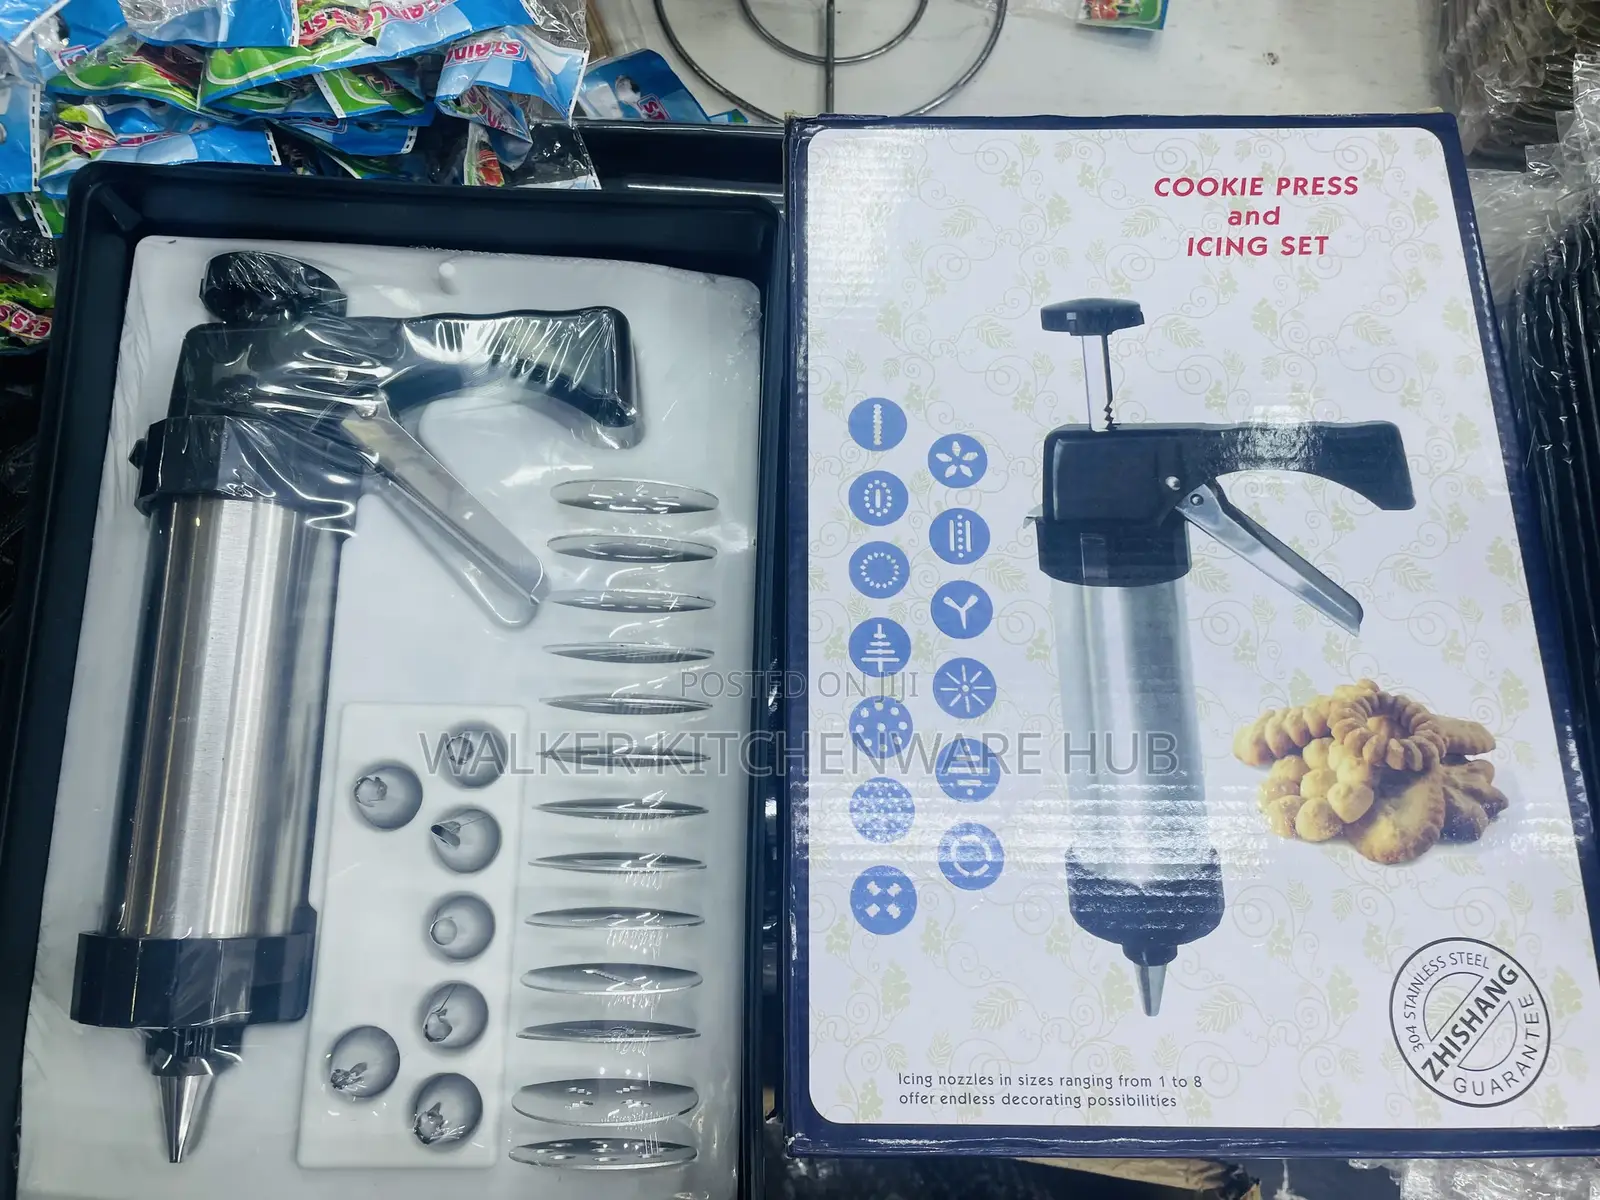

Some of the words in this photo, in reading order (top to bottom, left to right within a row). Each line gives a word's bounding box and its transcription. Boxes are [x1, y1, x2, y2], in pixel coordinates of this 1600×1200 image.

[1154, 177, 1264, 197] COOKIE
[1276, 176, 1358, 196] PRESS
[1228, 206, 1280, 226] and
[1187, 236, 1268, 257] ICING
[1280, 235, 1329, 256] SET
[1449, 952, 1490, 970] STEEL
[1404, 955, 1447, 1020] STAINLESS
[1421, 963, 1519, 1083] ZHISHANG
[1405, 1025, 1425, 1053] 304
[1453, 993, 1541, 1097] GUARANTEE
[898, 1072, 932, 1087] Icing
[938, 1073, 994, 1086] nozzles
[999, 1073, 1012, 1086] in
[1018, 1073, 1054, 1087] sizes
[1059, 1074, 1113, 1089] ranging
[1118, 1074, 1152, 1088] from
[1172, 1076, 1187, 1088] to
[1194, 1075, 1202, 1088] 8
[899, 1092, 935, 1105] offer
[940, 1092, 995, 1105] endless
[1001, 1092, 1081, 1108] decorating
[1087, 1093, 1177, 1109] possibilities
